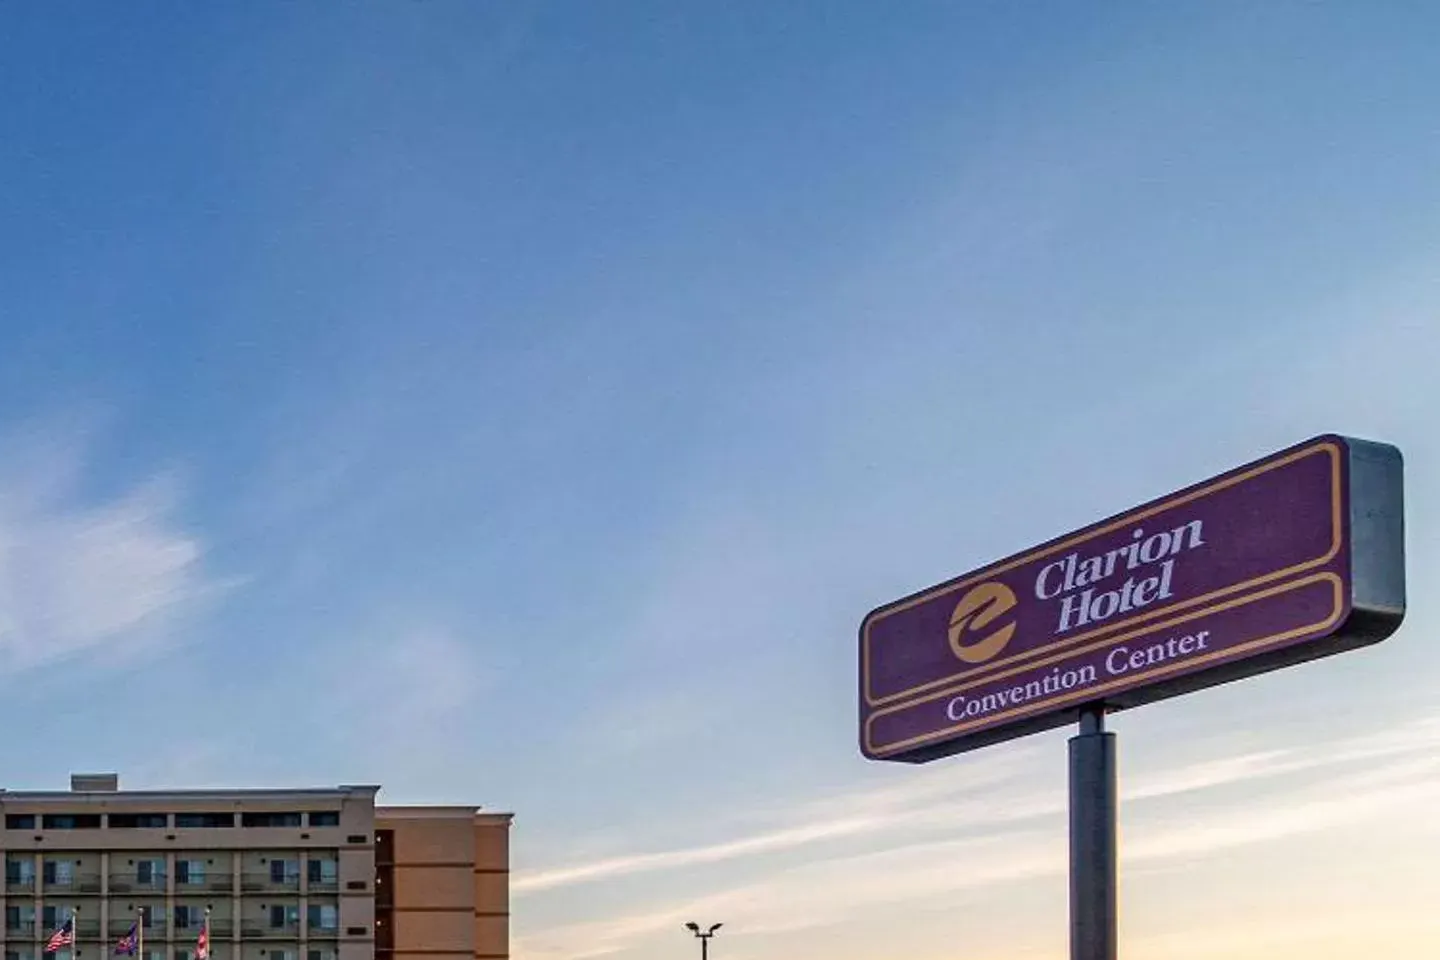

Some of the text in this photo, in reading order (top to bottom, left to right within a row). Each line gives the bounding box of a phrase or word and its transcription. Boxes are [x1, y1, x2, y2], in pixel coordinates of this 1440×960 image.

[1035, 519, 1207, 600] Clarion
[1054, 559, 1174, 634] Hotel
[947, 630, 1209, 721] Convention Center
